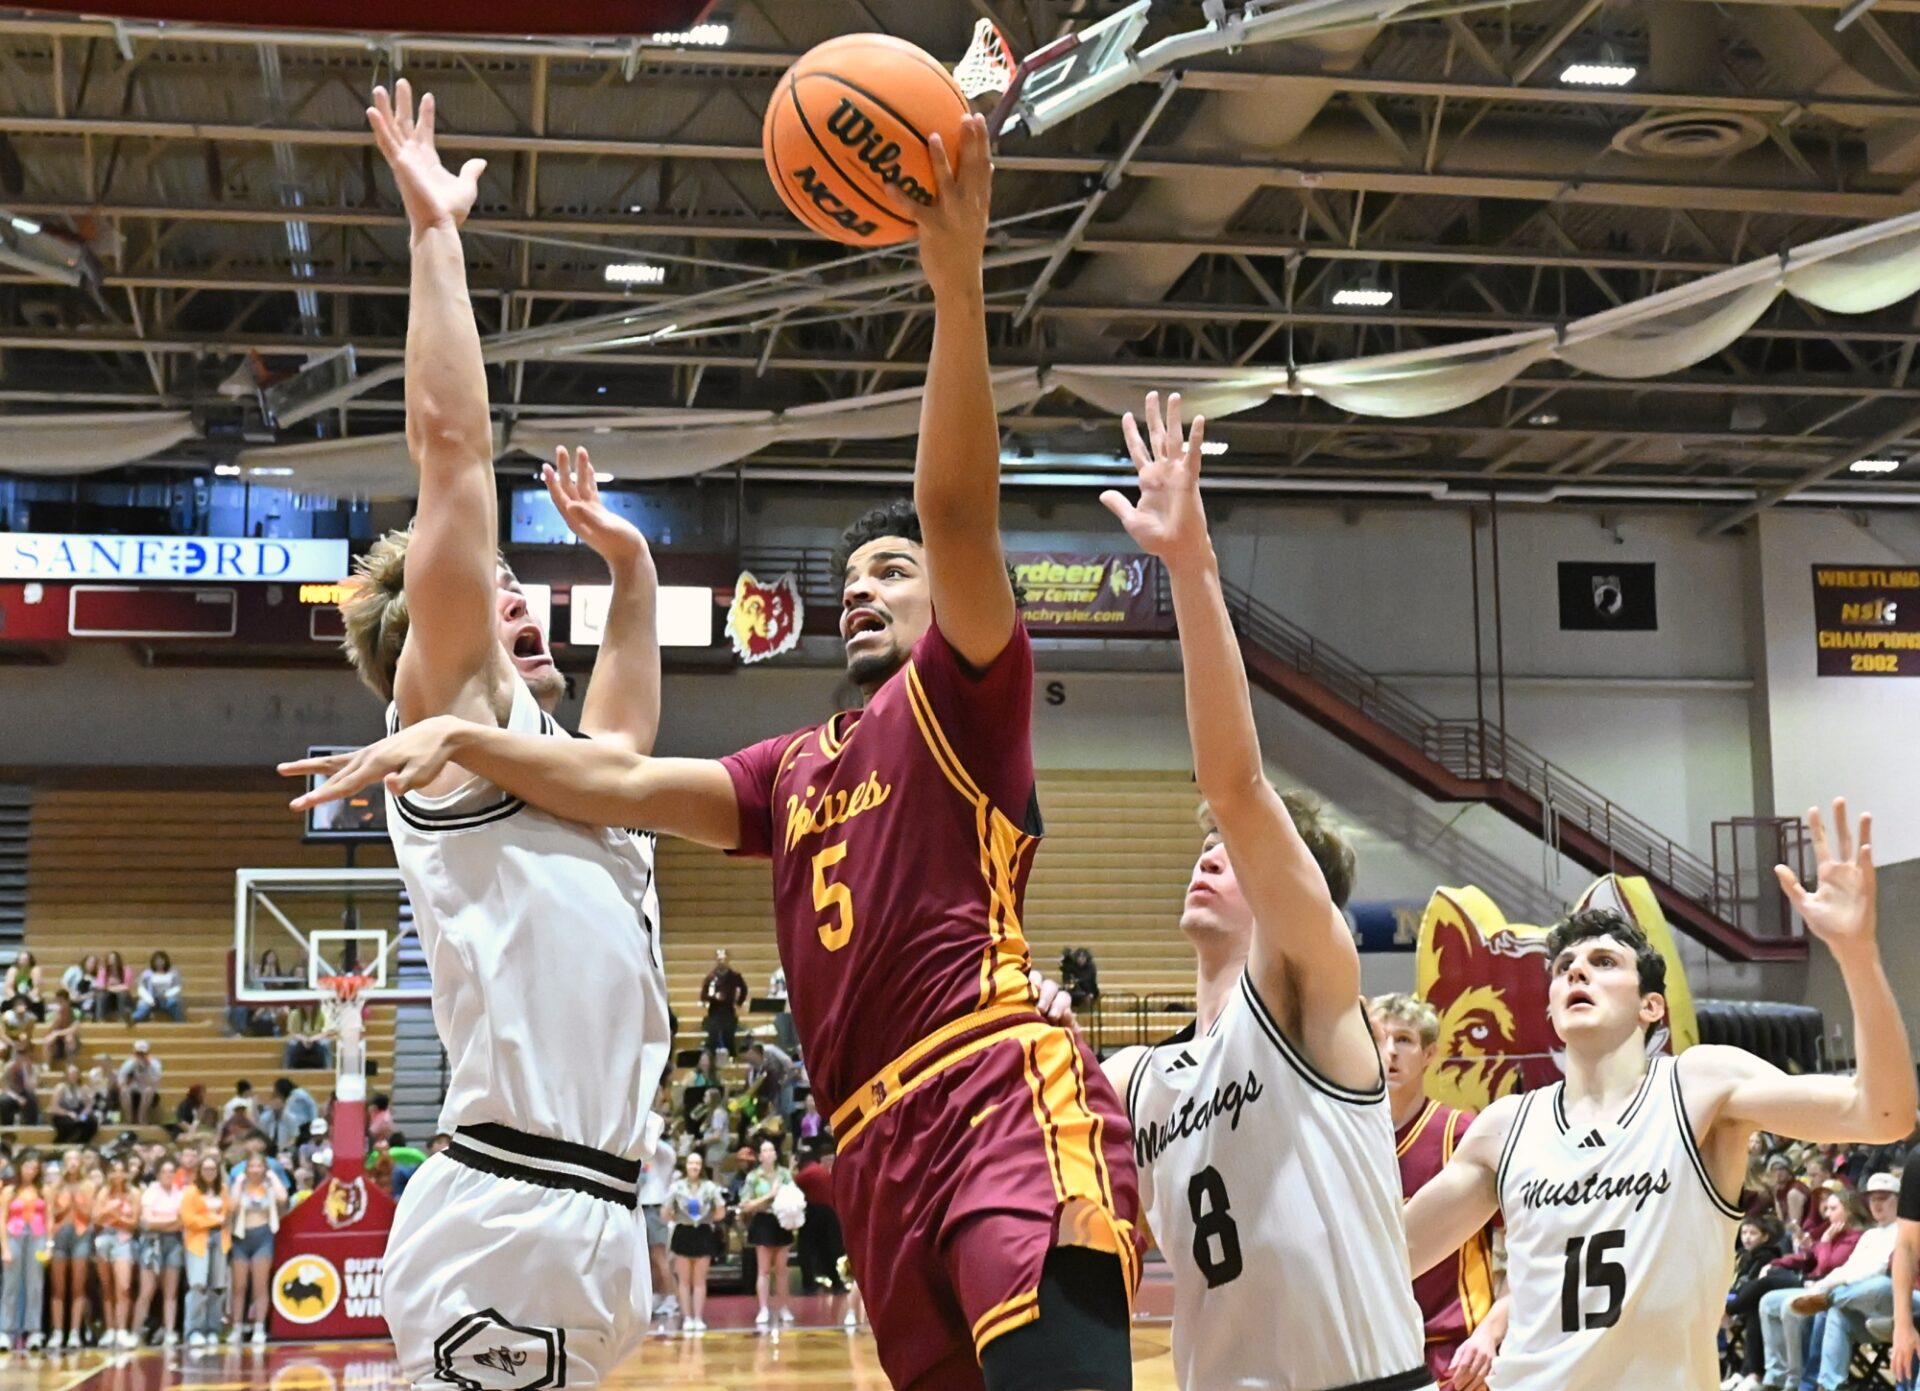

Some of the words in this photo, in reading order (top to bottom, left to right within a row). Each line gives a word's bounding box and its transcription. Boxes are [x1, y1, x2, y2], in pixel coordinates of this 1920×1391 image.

[826, 96, 934, 207] Wilson
[793, 165, 880, 237] NCAA
[14, 540, 291, 577] SANFORD
[1817, 569, 1920, 588] WRESTLING
[1044, 589, 1098, 602] Center
[1851, 653, 1899, 672] 2002
[1046, 681, 1066, 705] S
[811, 840, 854, 952] 5
[1135, 1069, 1264, 1169] Mustangs
[1520, 1168, 1671, 1212] Mustangs
[1188, 1165, 1243, 1289] 8
[1561, 1229, 1627, 1333] 15
